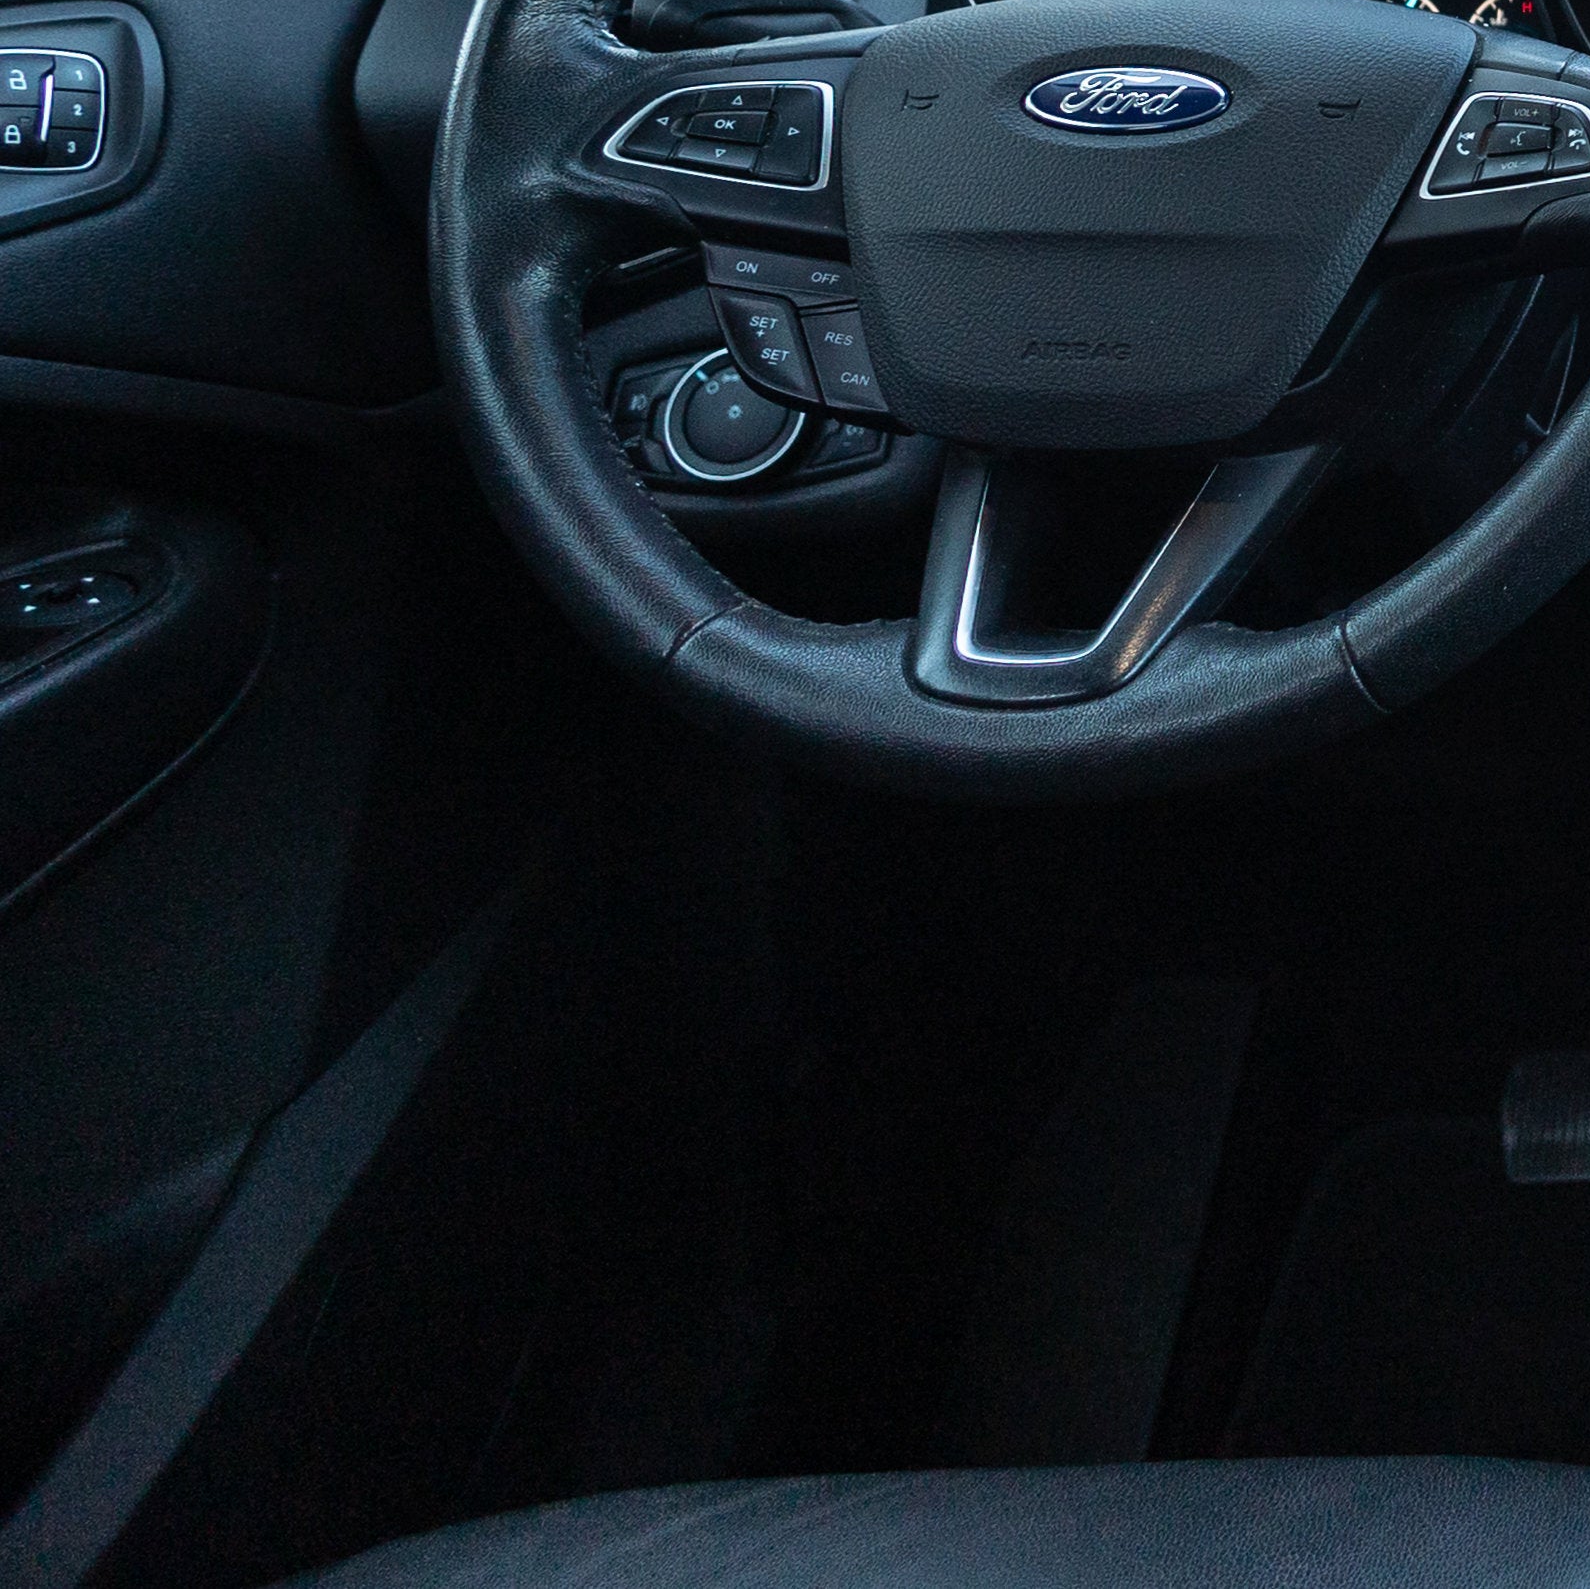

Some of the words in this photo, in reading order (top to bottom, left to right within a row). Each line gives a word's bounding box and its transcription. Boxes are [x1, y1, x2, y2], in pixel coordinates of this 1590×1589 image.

[1522, 2, 1533, 13] H
[75, 70, 83, 81] 1
[1060, 72, 1188, 114] Ford
[73, 103, 83, 116] 2
[714, 118, 737, 130] OK
[67, 140, 76, 153] 3
[735, 261, 758, 274] ON
[811, 271, 840, 285] OFF
[750, 315, 778, 329] SET
[824, 331, 854, 346] RES
[761, 347, 790, 361] SET
[840, 371, 870, 386] CAN
